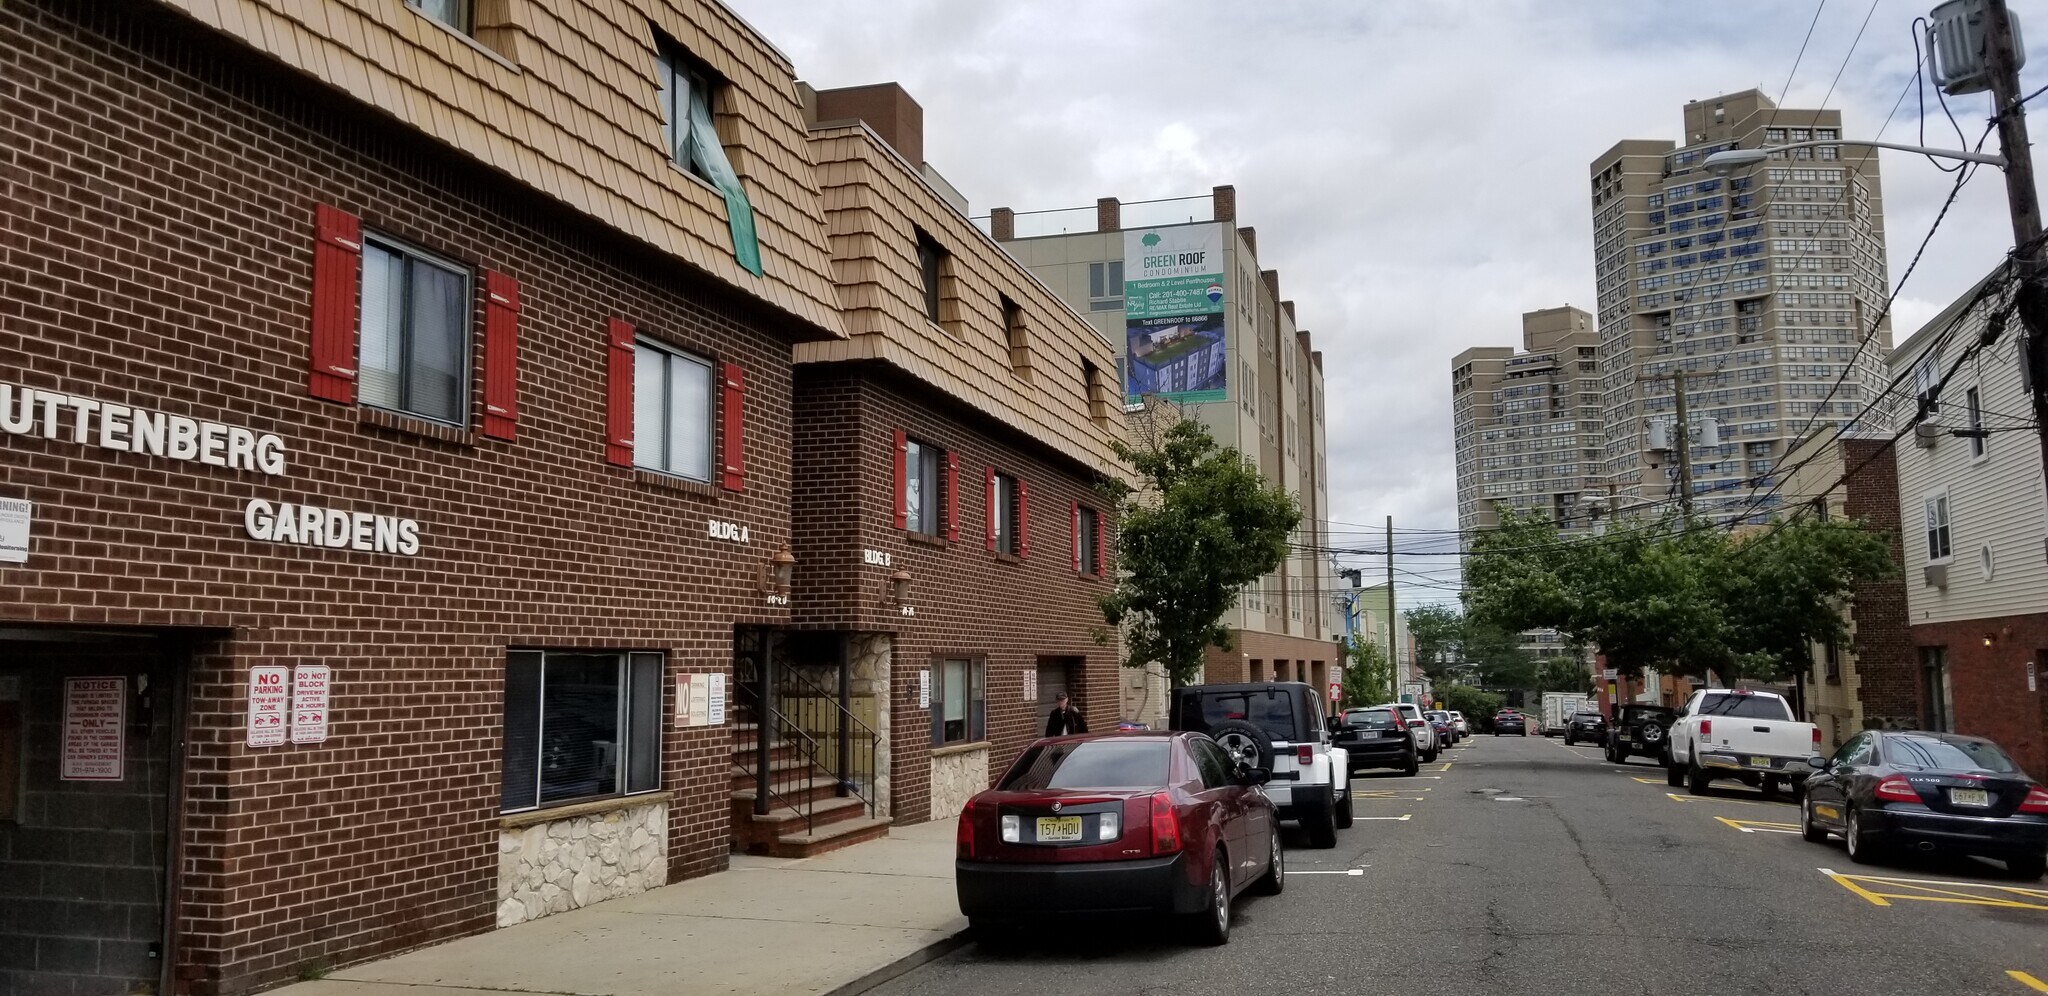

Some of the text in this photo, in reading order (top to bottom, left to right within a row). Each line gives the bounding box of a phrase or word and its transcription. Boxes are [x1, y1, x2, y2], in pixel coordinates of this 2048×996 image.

[1144, 252, 1205, 268] GREEN ROOF
[1144, 266, 1206, 277] CONDOMINIUM
[1162, 288, 1204, 298] 201-400-7487
[244, 499, 420, 556] GARDENS
[741, 526, 749, 543] A
[885, 553, 891, 567] B
[258, 674, 280, 685] NO
[254, 686, 283, 694] PARKING
[676, 682, 689, 714] NO
[82, 719, 105, 728] ONLY
